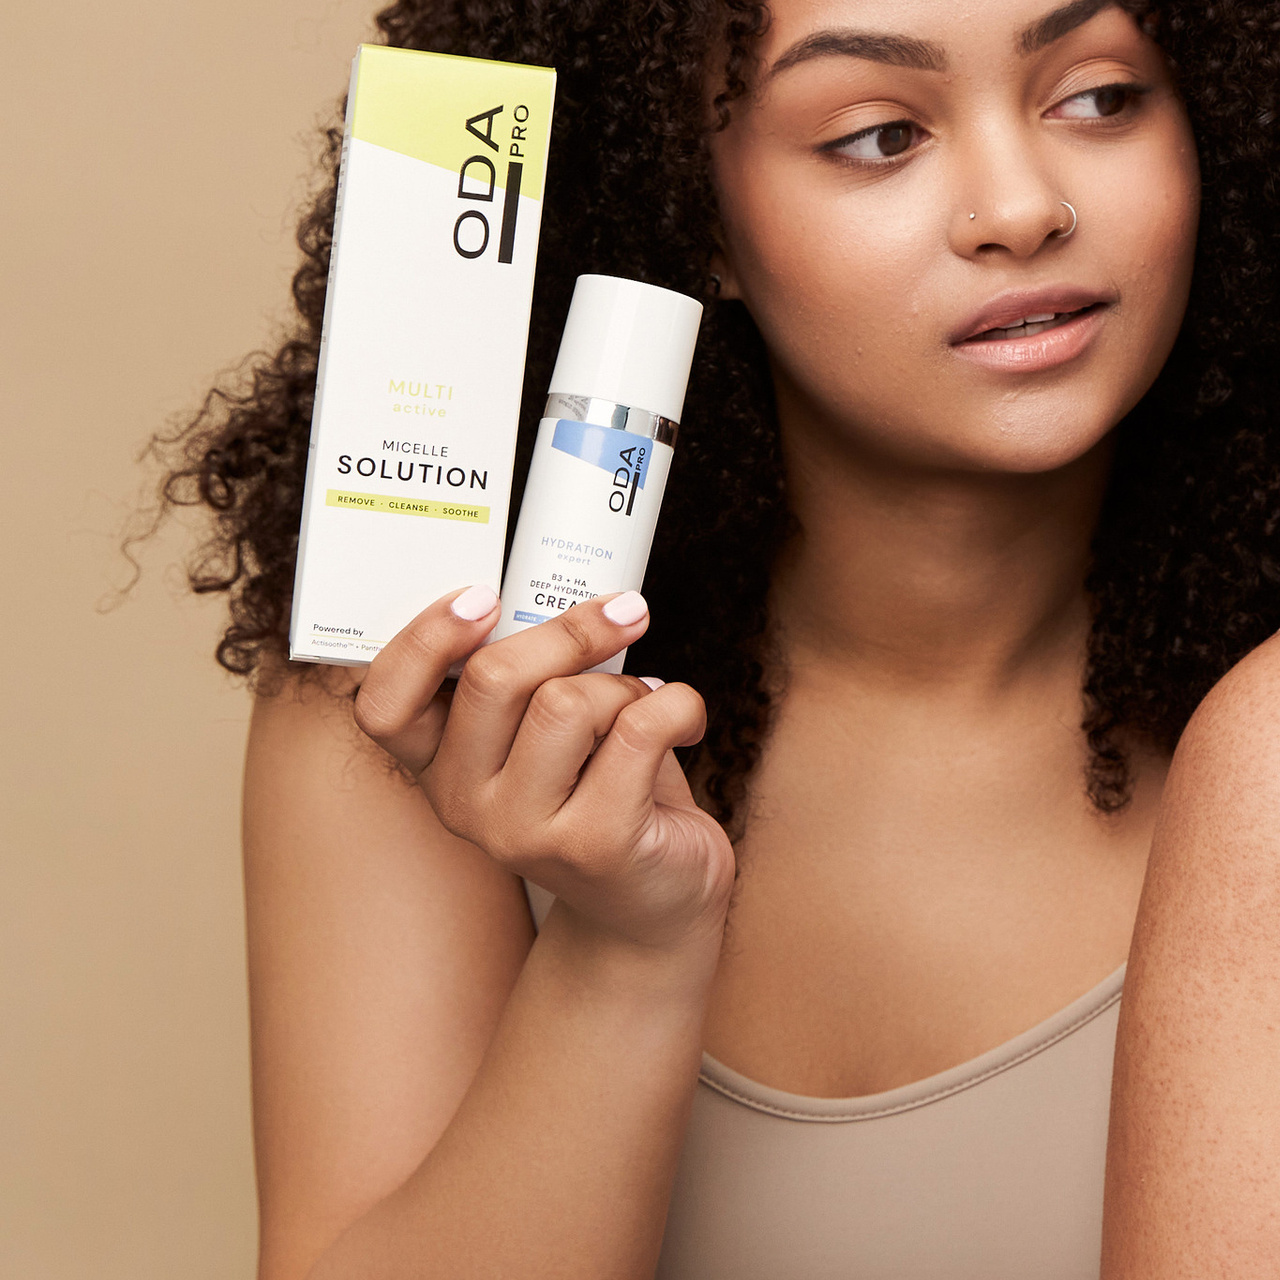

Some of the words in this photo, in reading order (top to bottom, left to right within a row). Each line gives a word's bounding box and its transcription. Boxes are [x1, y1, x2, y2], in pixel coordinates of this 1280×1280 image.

[509, 104, 530, 158] PRO
[453, 104, 504, 260] ODA
[388, 379, 453, 400] MULTI
[392, 402, 447, 418] active
[382, 440, 449, 458] MICELLE
[635, 447, 646, 472] PRO
[337, 454, 488, 490] SOLUTION
[608, 446, 637, 512] ODA
[338, 496, 376, 506] REMOVE
[388, 501, 430, 512] CLEANSE
[442, 507, 479, 518] SOOTHE
[541, 536, 614, 560] HYDRATION
[557, 552, 591, 566] expert
[530, 580, 552, 590] DEEP
[554, 585, 599, 598] HYDRATIO
[552, 573, 563, 582] B3
[574, 578, 587, 587] HA
[534, 593, 577, 610] CREA
[313, 624, 351, 634] Powered
[353, 628, 364, 637] by
